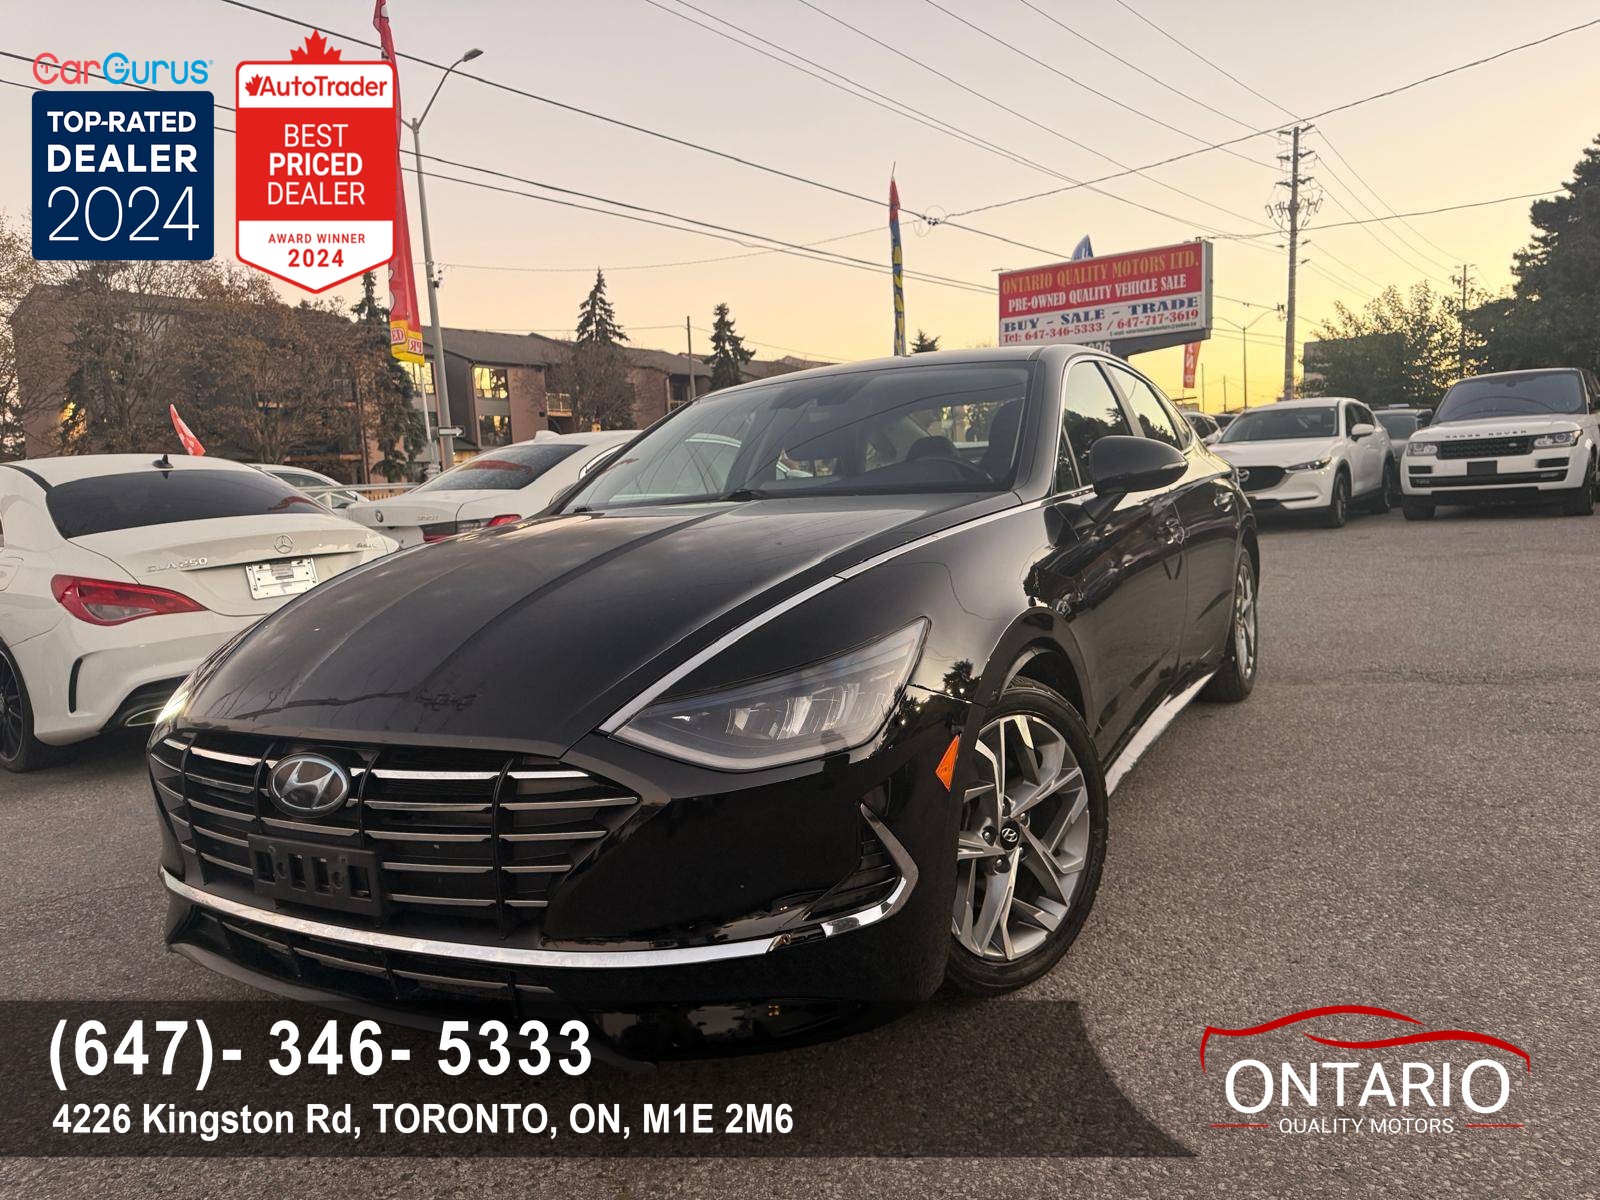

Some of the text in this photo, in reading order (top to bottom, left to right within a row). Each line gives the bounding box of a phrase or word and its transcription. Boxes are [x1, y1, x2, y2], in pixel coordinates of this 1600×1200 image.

[1003, 250, 1199, 295] ONTARIO QUALITY MOTORS LTD.
[1008, 274, 1187, 312] PRE-OWNED QUALITY VEHICLE SALE
[1003, 317, 1039, 333] BUY
[1060, 308, 1105, 325] SALE
[1127, 296, 1198, 315] TRADE
[1003, 332, 1021, 344] Tel:
[1024, 322, 1102, 341] 647-346-5333
[1116, 309, 1199, 329] 647-717-3619
